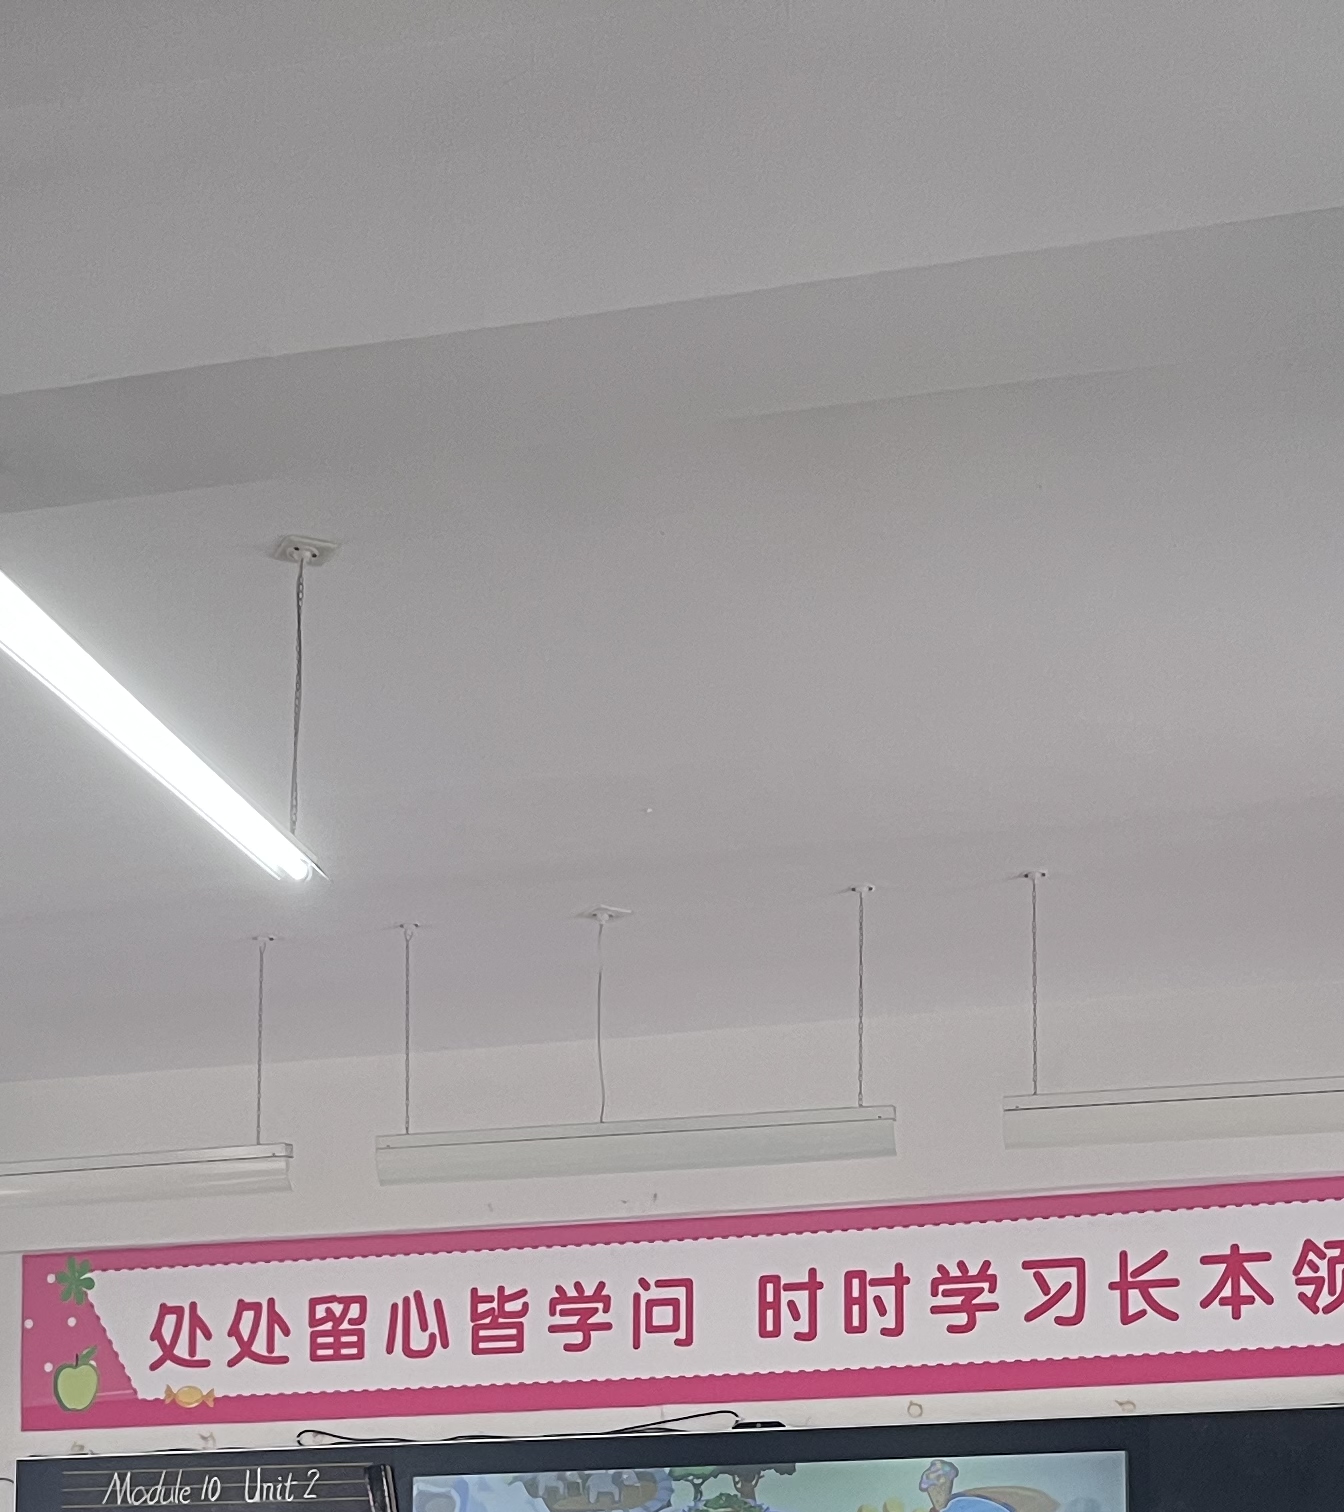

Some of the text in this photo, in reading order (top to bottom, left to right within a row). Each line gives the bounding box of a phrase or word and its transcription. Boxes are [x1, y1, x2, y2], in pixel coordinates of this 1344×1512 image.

[149, 1277, 695, 1372] 处处留心皆学问
[102, 1467, 320, 1506] Module 10 Unit 2
